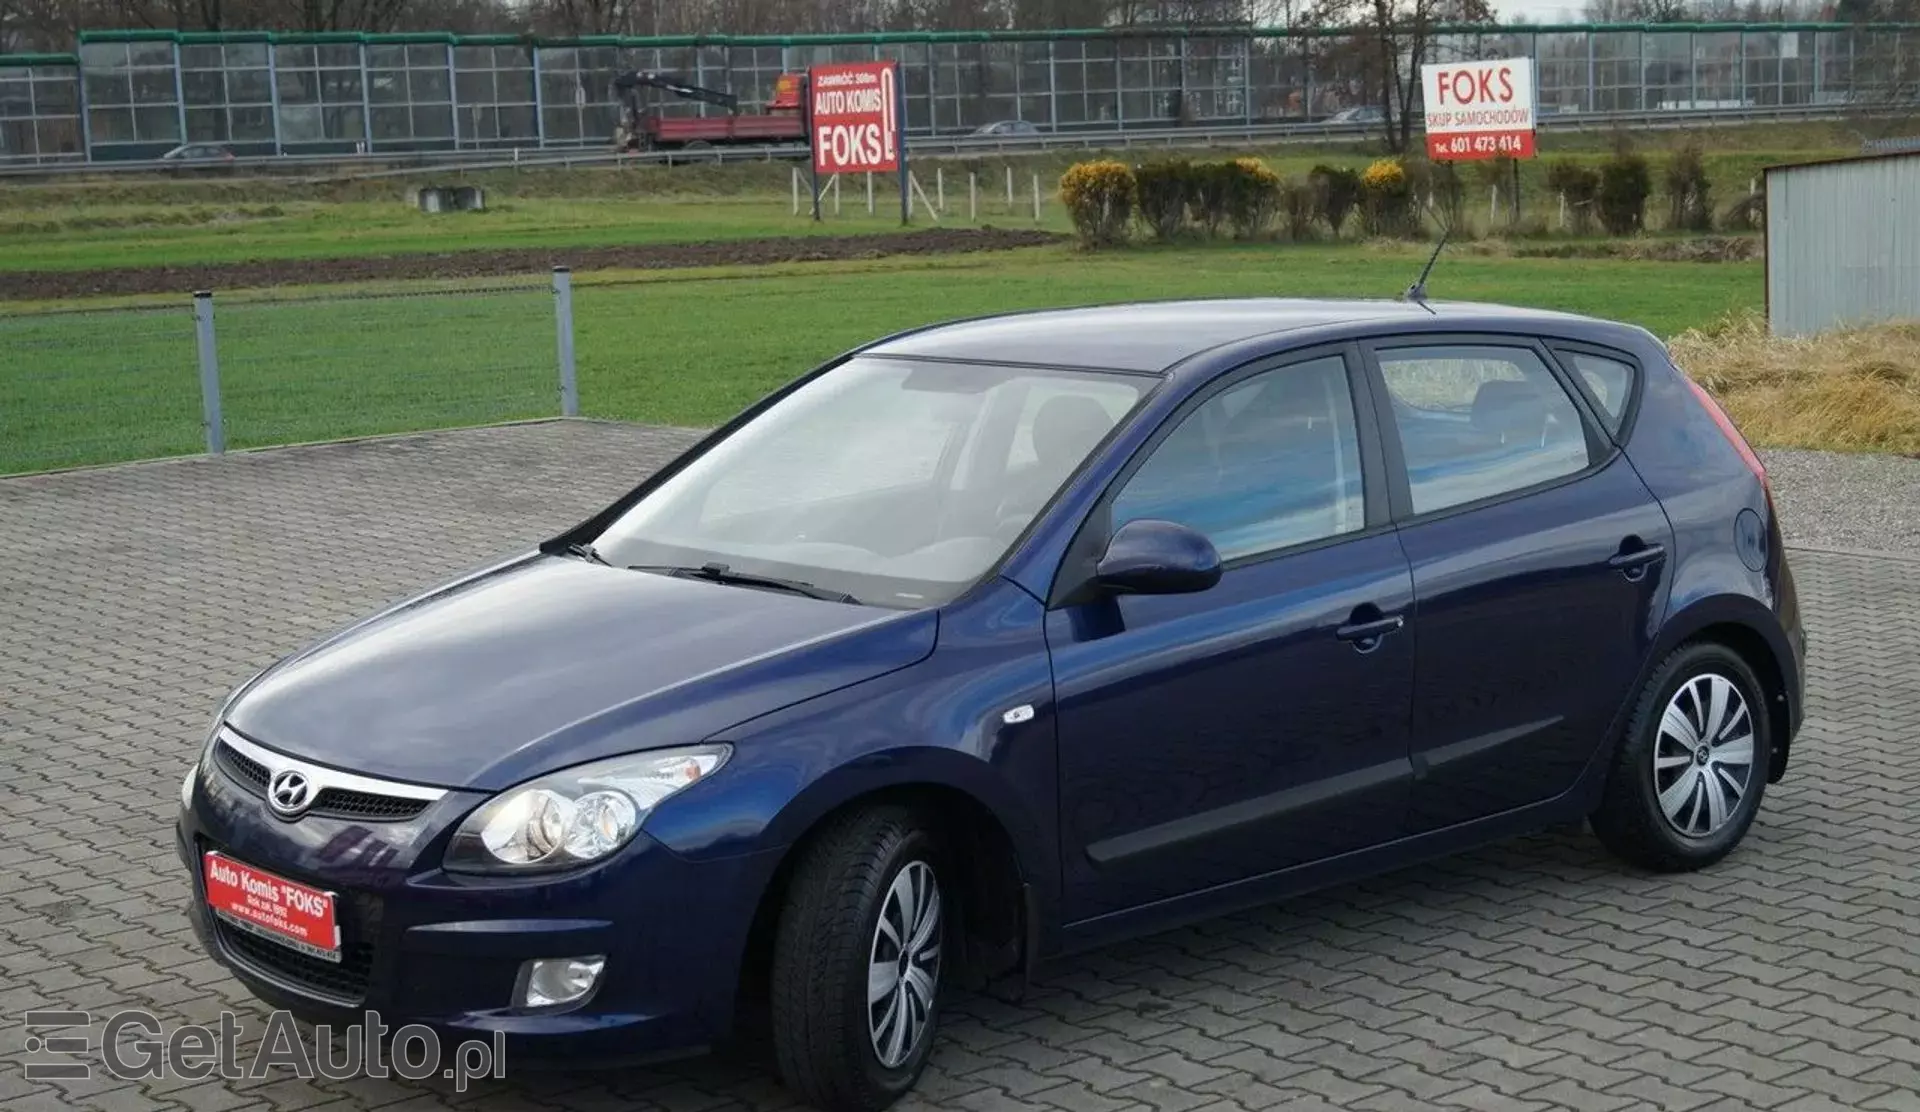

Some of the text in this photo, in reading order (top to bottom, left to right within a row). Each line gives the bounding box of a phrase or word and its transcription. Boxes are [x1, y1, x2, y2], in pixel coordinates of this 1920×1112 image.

[815, 88, 882, 115] AUTO KOMIS
[1438, 67, 1513, 105] FOKS
[1427, 105, 1529, 127] SKUP SAMOCHODÓW
[818, 123, 882, 166] FOKS
[1451, 137, 1471, 153] 601
[1474, 136, 1496, 152] 473
[1499, 134, 1522, 151] 414
[210, 860, 329, 918] Auto Komis "FOKS"
[230, 902, 308, 938] www.autofoks.com
